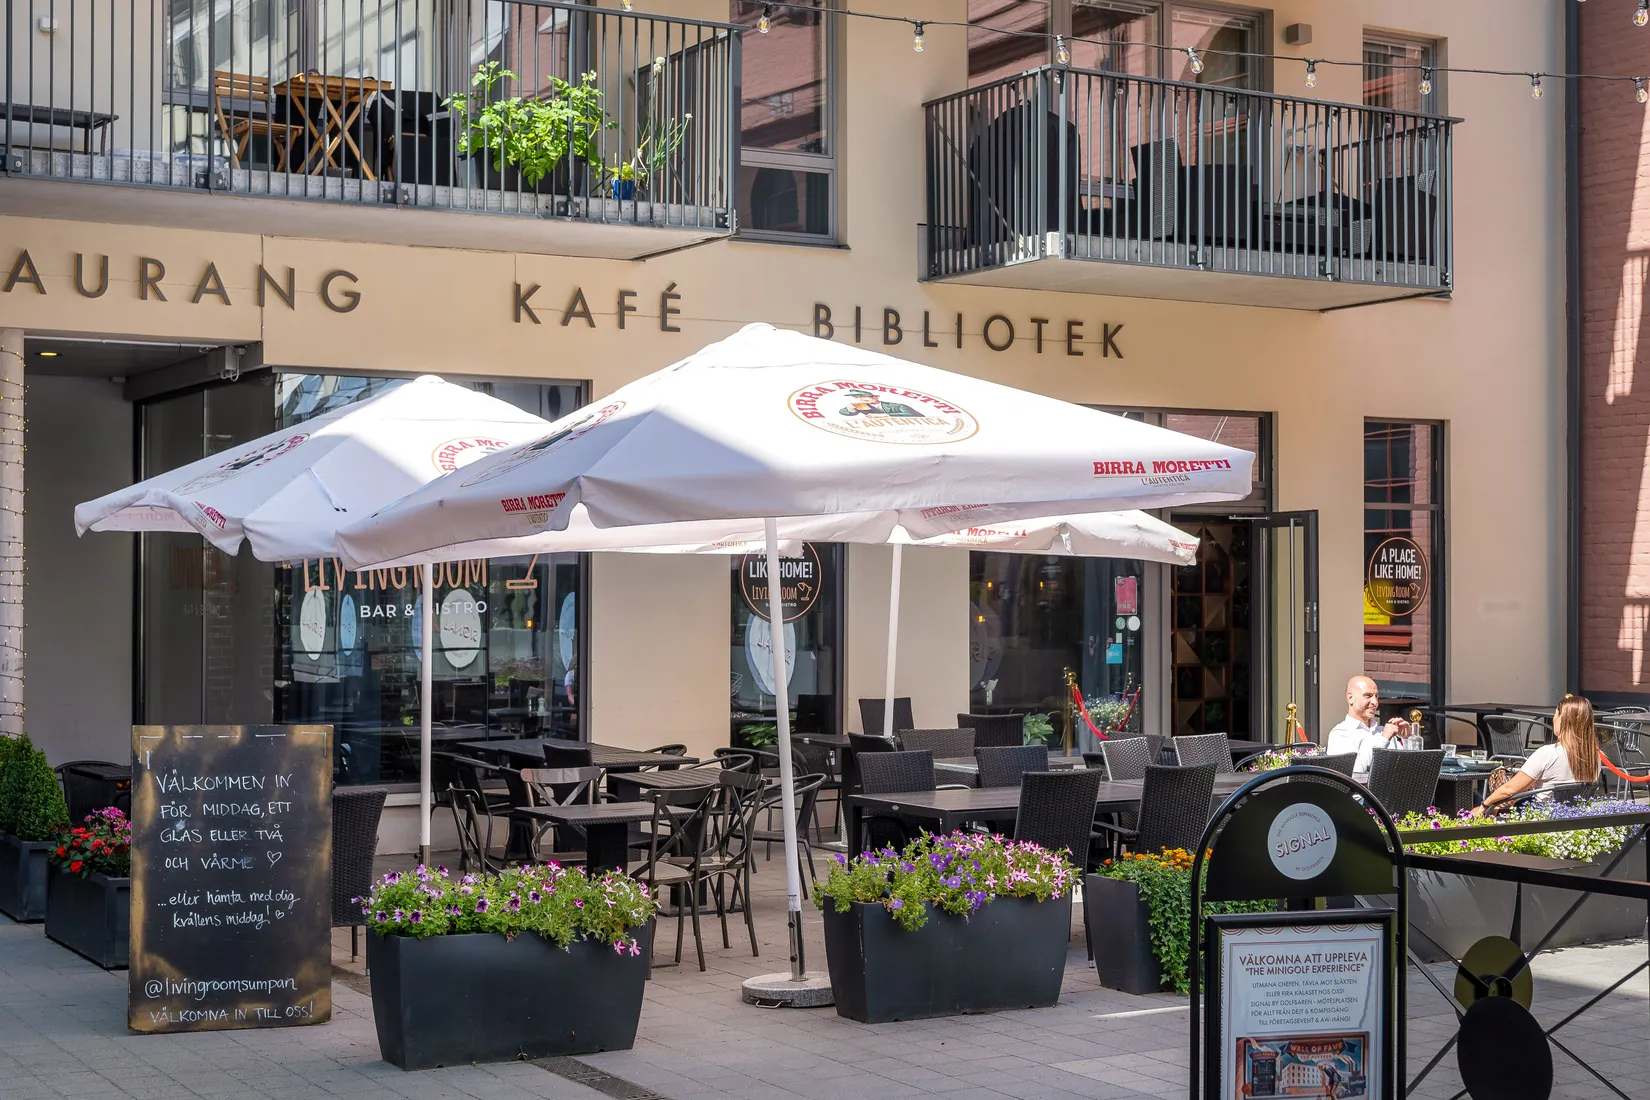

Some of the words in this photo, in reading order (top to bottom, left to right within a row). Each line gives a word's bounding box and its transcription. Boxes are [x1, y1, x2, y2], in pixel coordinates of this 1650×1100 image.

[4, 249, 362, 314] AURANG
[513, 282, 682, 333] KAFÉ
[813, 303, 1125, 359] BIBLIOTEK
[796, 386, 836, 420] BIRRA
[833, 381, 962, 416] MORETTI
[845, 416, 951, 429] L'AUTENTICA
[1092, 461, 1147, 475] BIRRA
[1152, 459, 1232, 474] MORETTI
[1141, 474, 1191, 486] L'AUTENTICA
[501, 497, 527, 512] BIRRA
[1380, 547, 1387, 563] A
[1389, 548, 1416, 563] PLACE
[750, 561, 768, 578] LIK
[1374, 564, 1394, 579] LIKE
[1395, 564, 1422, 579] HOME!
[360, 604, 397, 618] BAR
[404, 603, 415, 616] &
[431, 600, 488, 615] ISTRO
[156, 769, 266, 793] VÄLKOMMEN
[275, 773, 292, 788] IN
[160, 801, 191, 819] FÖR
[268, 801, 292, 816] ETT
[160, 828, 202, 843] GLAS
[210, 830, 248, 842] ELLER
[255, 823, 284, 843] TVÅ
[1275, 825, 1332, 858] SIGNAL
[165, 857, 188, 870] OCH
[200, 853, 253, 870] VÄRME
[250, 889, 273, 902] med
[275, 889, 301, 909] dig
[173, 911, 221, 928] kvällens
[1239, 953, 1302, 966] VÄLKOMNA
[1304, 953, 1323, 964] ATT
[1324, 951, 1368, 963] UPPLEVA
[1266, 965, 1310, 976] MINIGOLF
[1311, 963, 1365, 974] EXPERIENCE"
[144, 976, 298, 1001] @livingroomsumpan
[1252, 981, 1277, 989] UTMANA
[1302, 979, 1320, 987] TÄVLA
[150, 1006, 229, 1024] VÄLKOMNA
[235, 1008, 247, 1020] IN
[255, 1007, 282, 1019] TILL
[285, 1001, 313, 1018] OSS!
[1290, 1045, 1310, 1053] WALL
